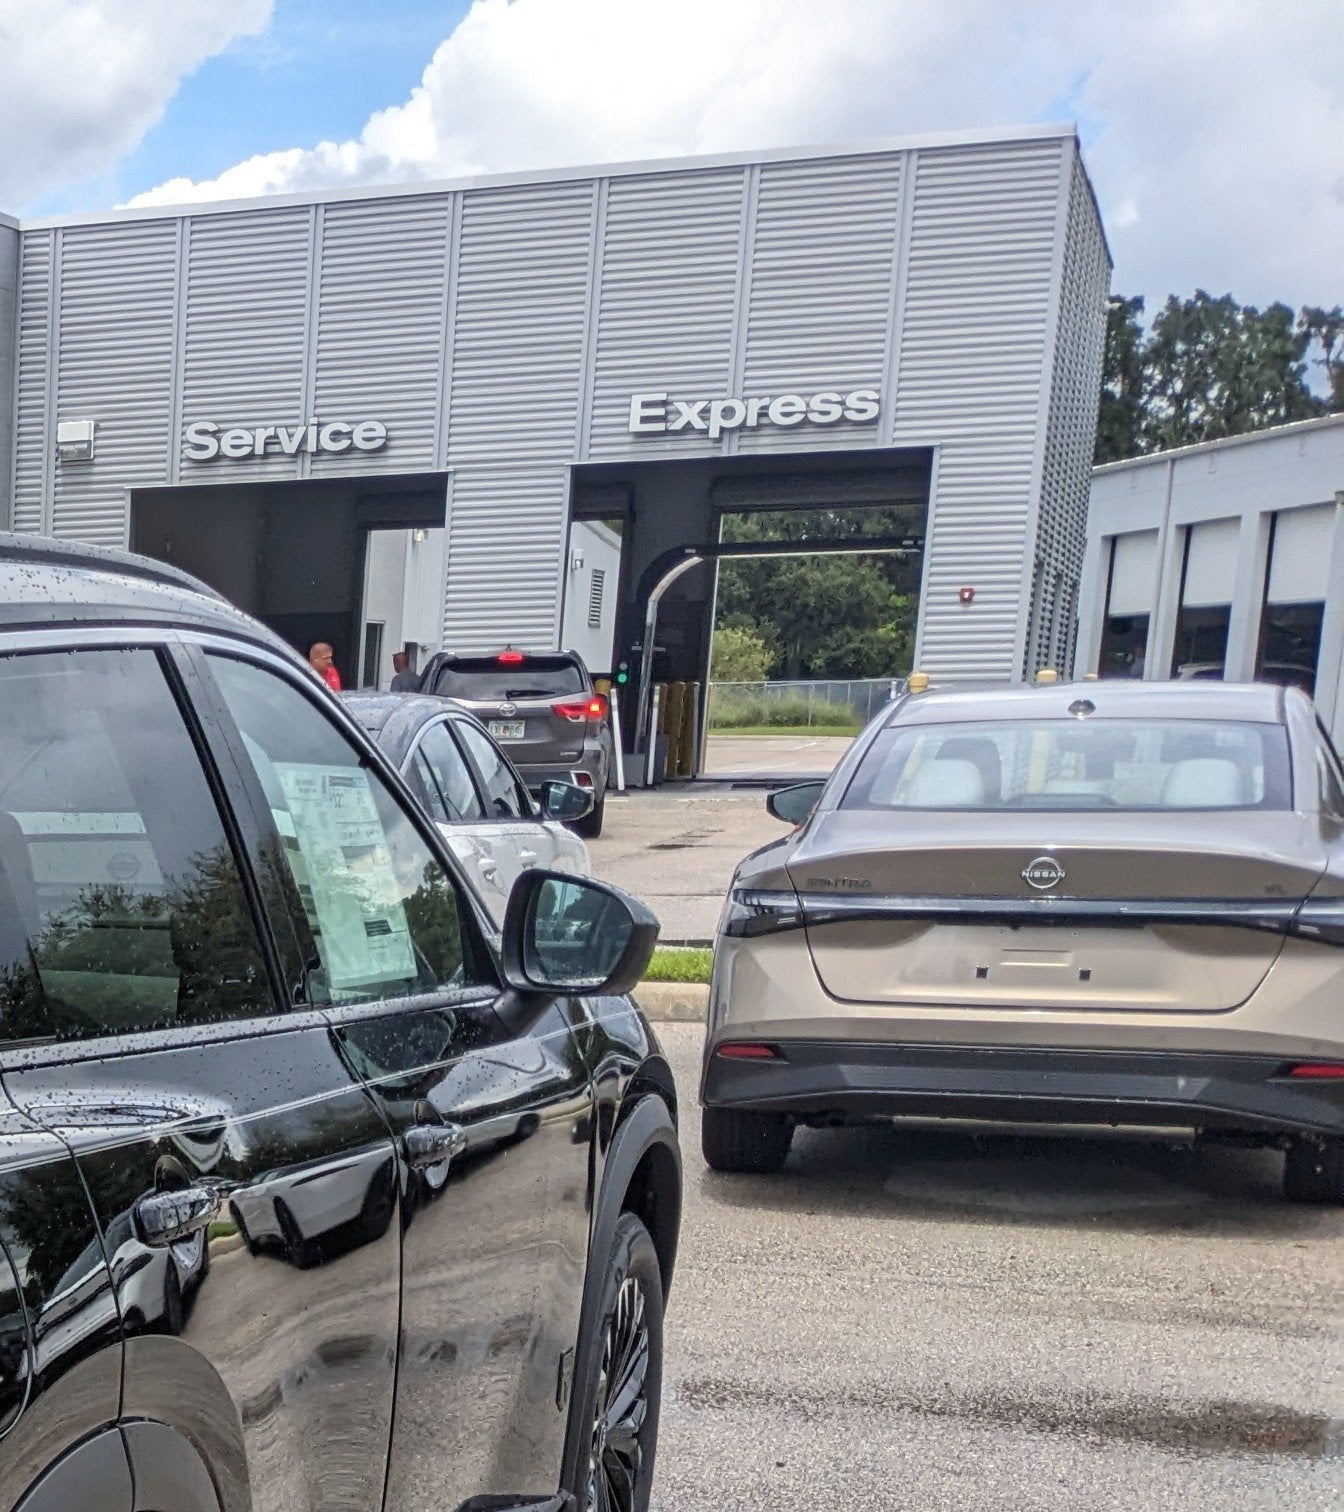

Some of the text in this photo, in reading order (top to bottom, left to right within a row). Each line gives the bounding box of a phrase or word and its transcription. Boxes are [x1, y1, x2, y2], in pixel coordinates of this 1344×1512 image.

[628, 389, 881, 439] Express
[182, 417, 389, 461] Service
[1021, 870, 1066, 878] NISSAN
